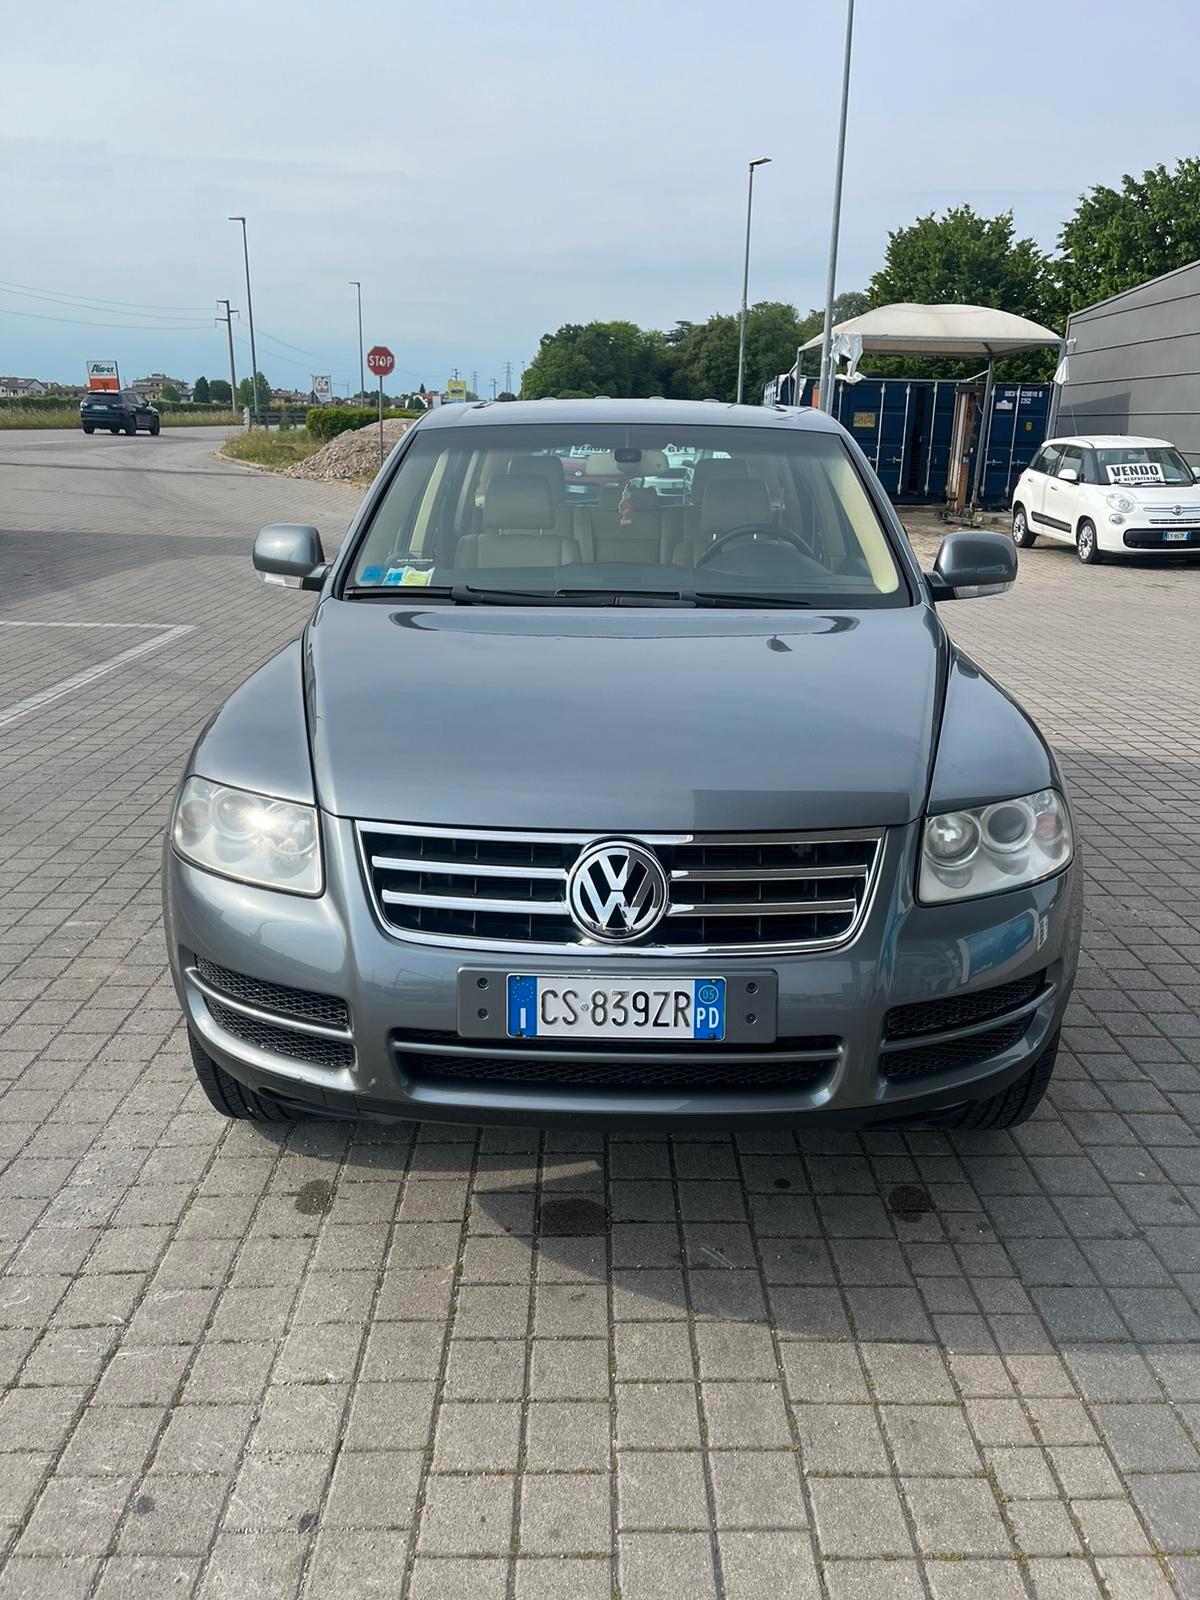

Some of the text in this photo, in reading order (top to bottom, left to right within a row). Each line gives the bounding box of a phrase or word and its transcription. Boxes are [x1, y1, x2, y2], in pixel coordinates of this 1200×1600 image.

[369, 355, 393, 367] STOP
[1110, 465, 1159, 476] VENDO
[702, 989, 715, 1000] 05
[696, 1007, 719, 1029] PD
